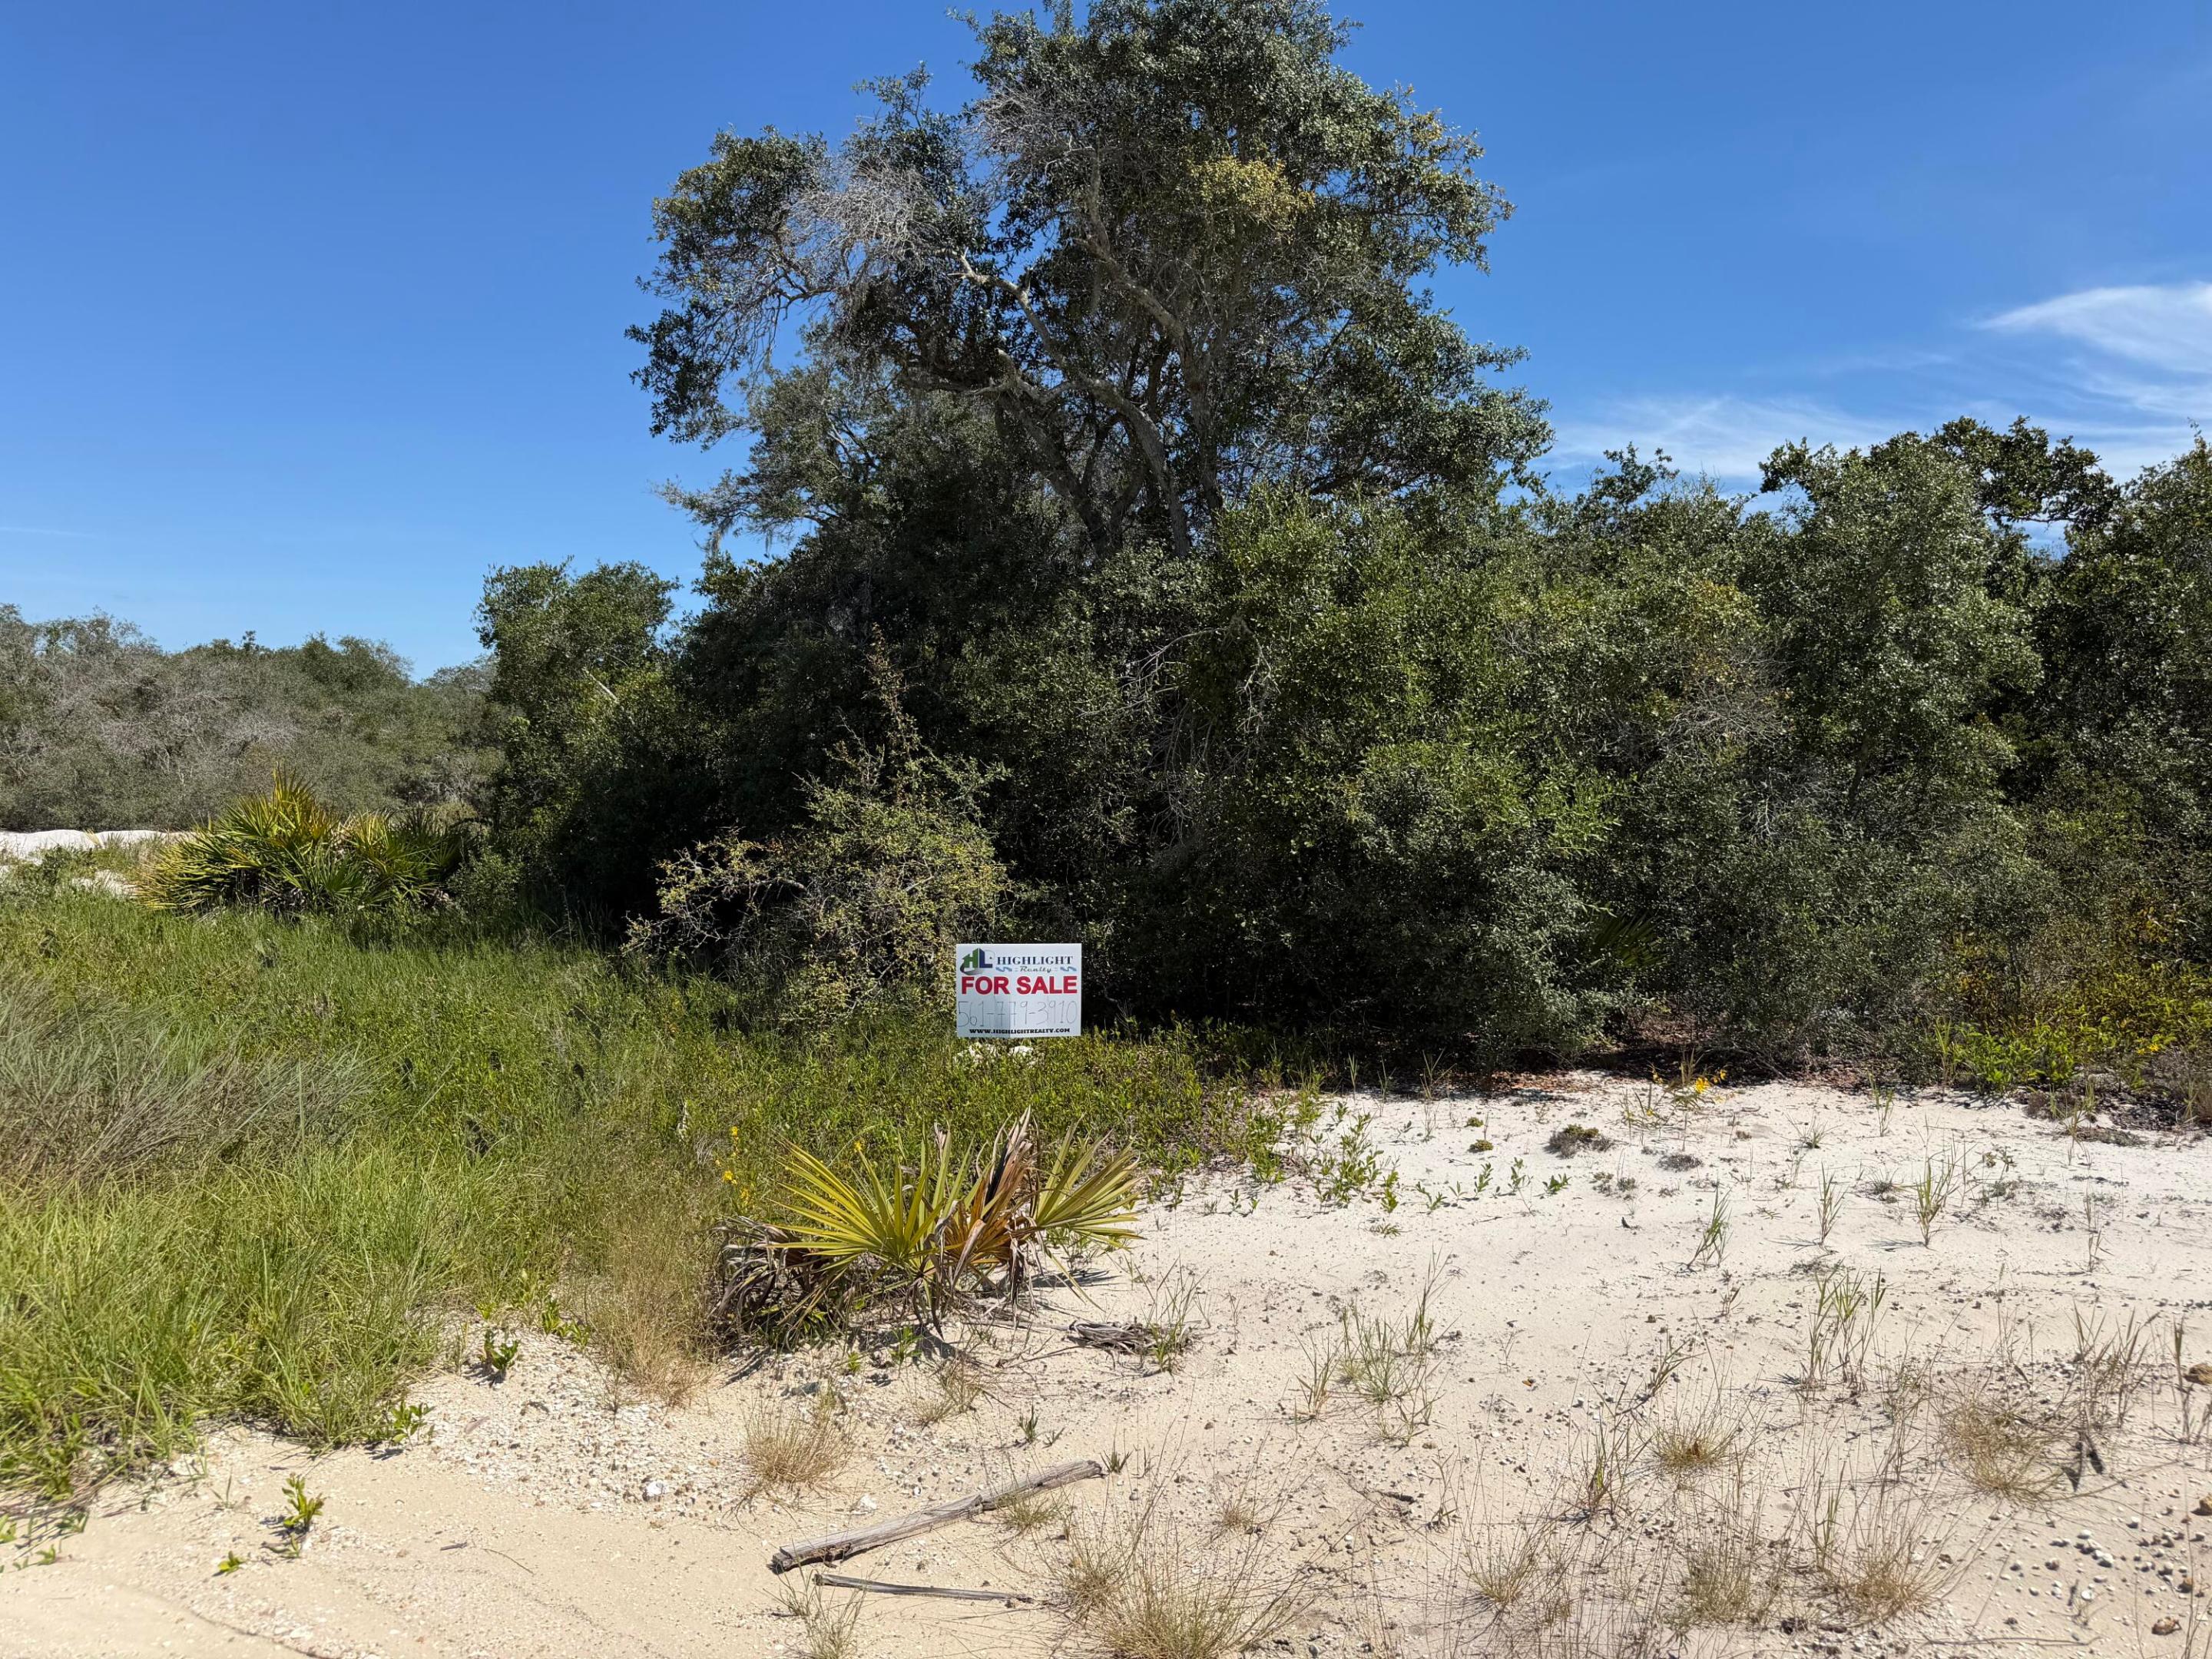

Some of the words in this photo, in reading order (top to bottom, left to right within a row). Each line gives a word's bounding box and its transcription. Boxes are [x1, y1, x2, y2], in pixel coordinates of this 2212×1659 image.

[997, 956, 1073, 965] HIGHLIGHT
[962, 976, 1010, 995] FOR
[1016, 976, 1078, 995] SALE
[958, 1001, 1078, 1027] 561-779-3910
